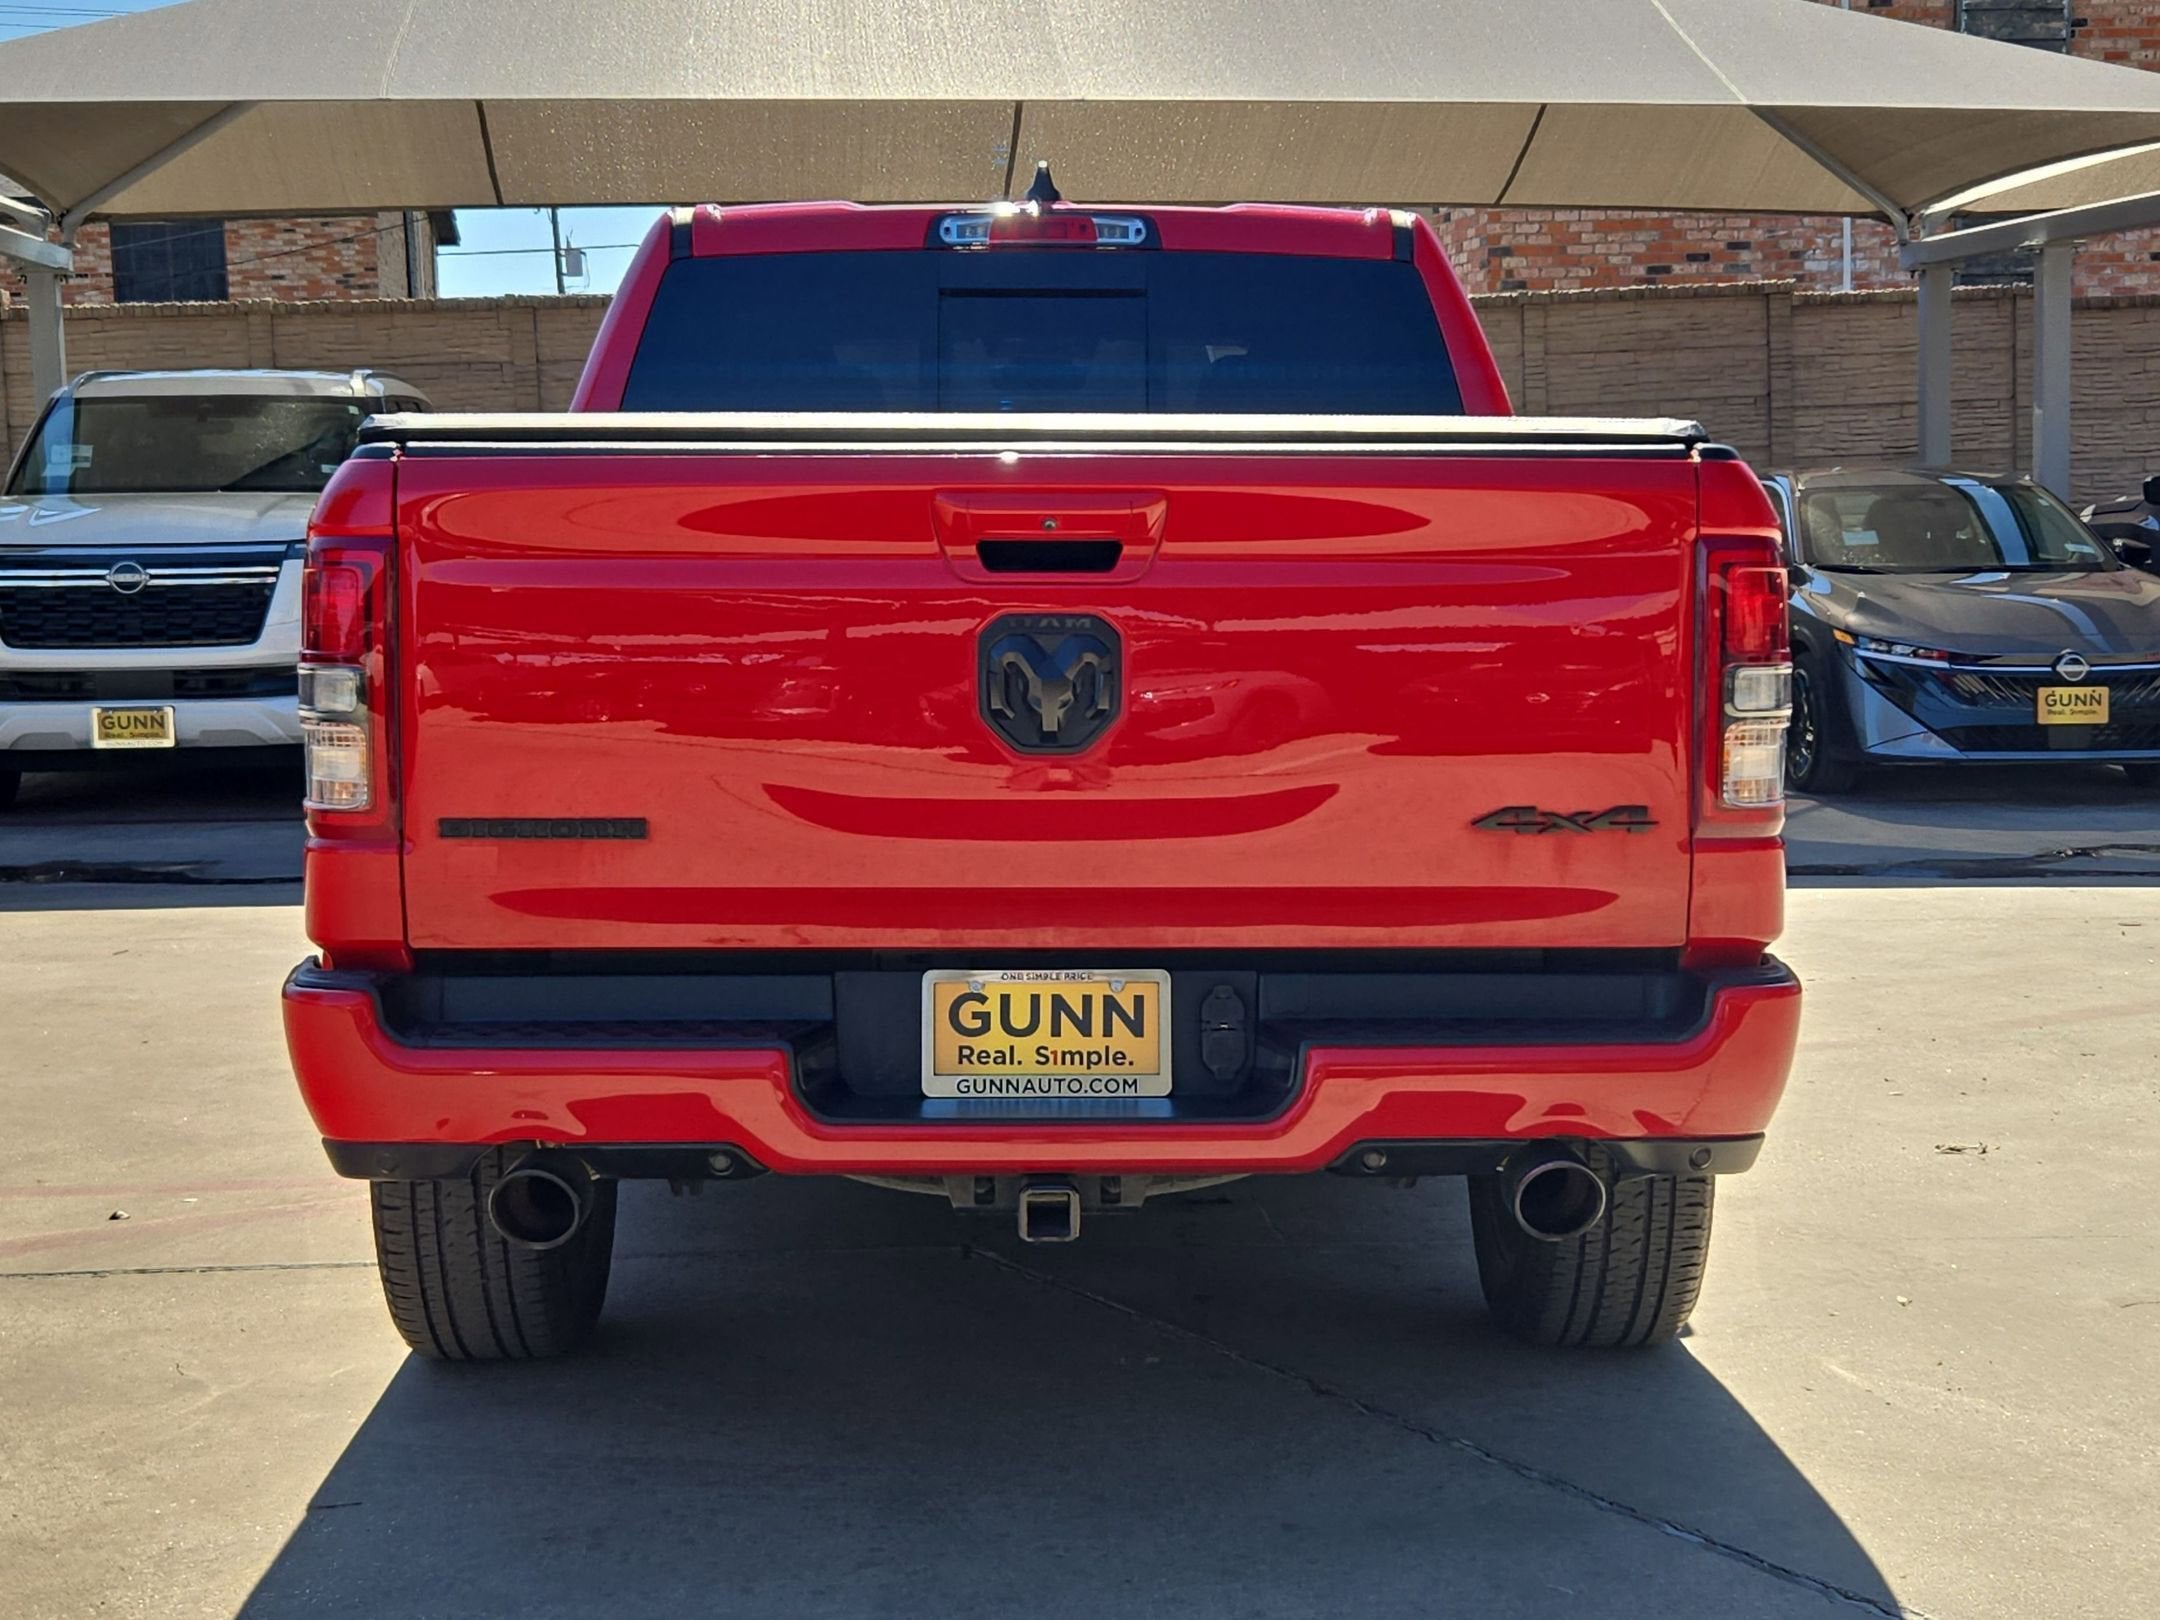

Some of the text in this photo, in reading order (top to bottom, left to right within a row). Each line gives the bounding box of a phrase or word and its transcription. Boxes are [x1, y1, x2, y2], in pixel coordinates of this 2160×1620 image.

[2045, 693, 2102, 707] GUNN
[101, 715, 165, 730] GUNN
[1001, 972, 1094, 981] ONE SIMPLE PRICE
[948, 991, 1145, 1039] GUNN
[958, 1044, 1023, 1066] Real.
[956, 1077, 1139, 1095] GUNNAUTO.COM
